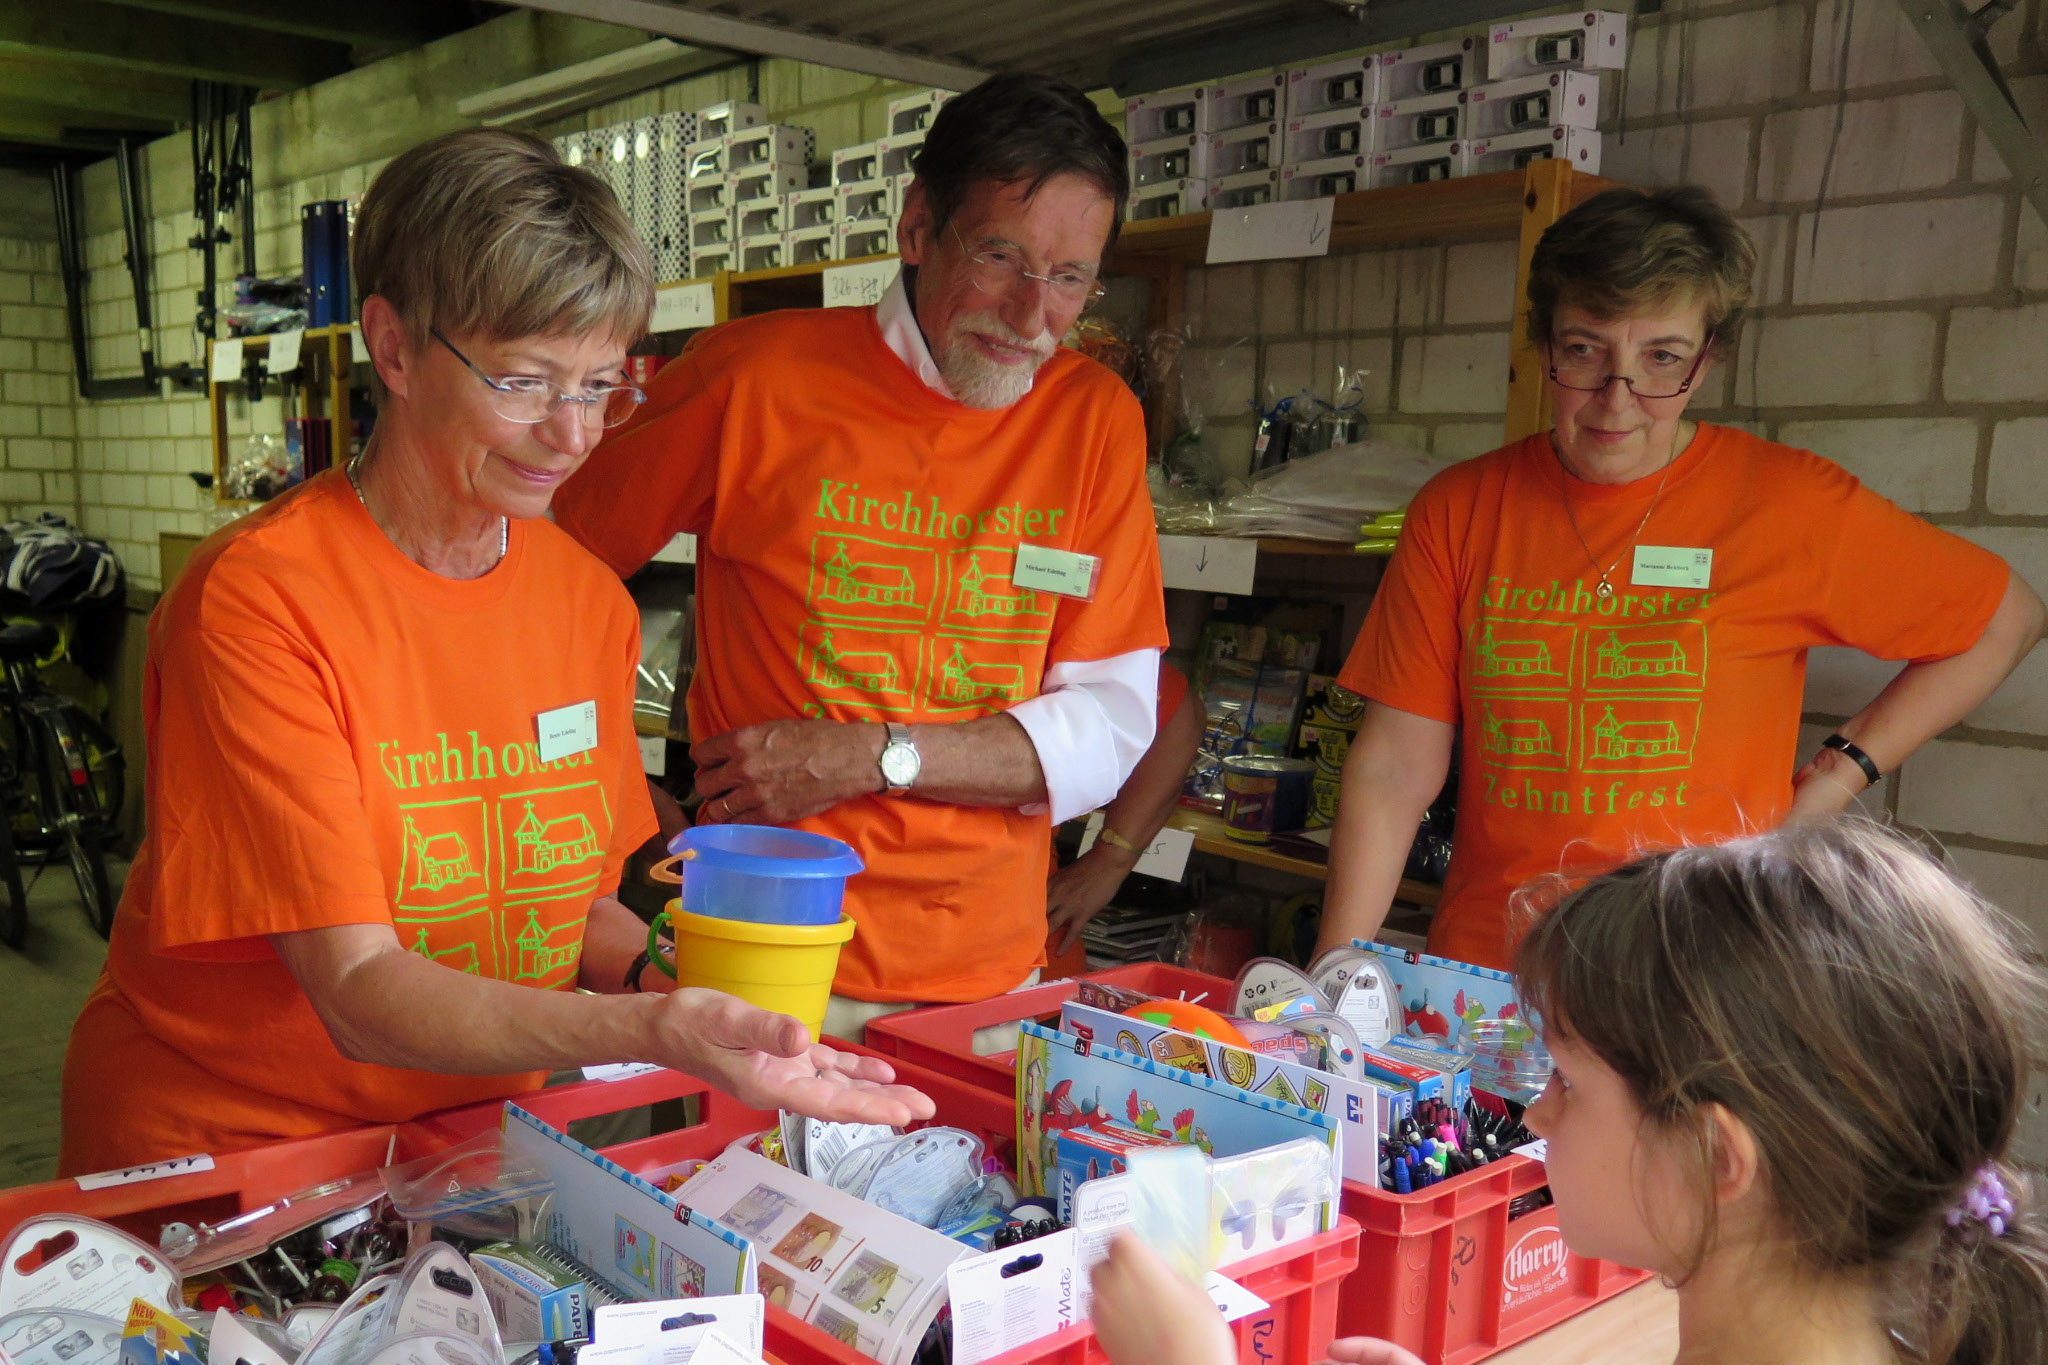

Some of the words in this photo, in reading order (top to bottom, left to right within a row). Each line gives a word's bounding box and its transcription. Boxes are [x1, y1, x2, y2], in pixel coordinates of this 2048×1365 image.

[814, 478, 1065, 540] Kirchhorster
[1477, 576, 1717, 618] Kirchhorster
[378, 730, 594, 789] irchhor
[1482, 774, 1688, 815] Zehntfest
[1252, 1034, 1308, 1053] Spac
[805, 1256, 824, 1273] 10
[1509, 1238, 1563, 1282] Harry
[132, 1302, 156, 1319] NEW
[570, 1294, 583, 1339] PAPE
[870, 1297, 886, 1315] 5
